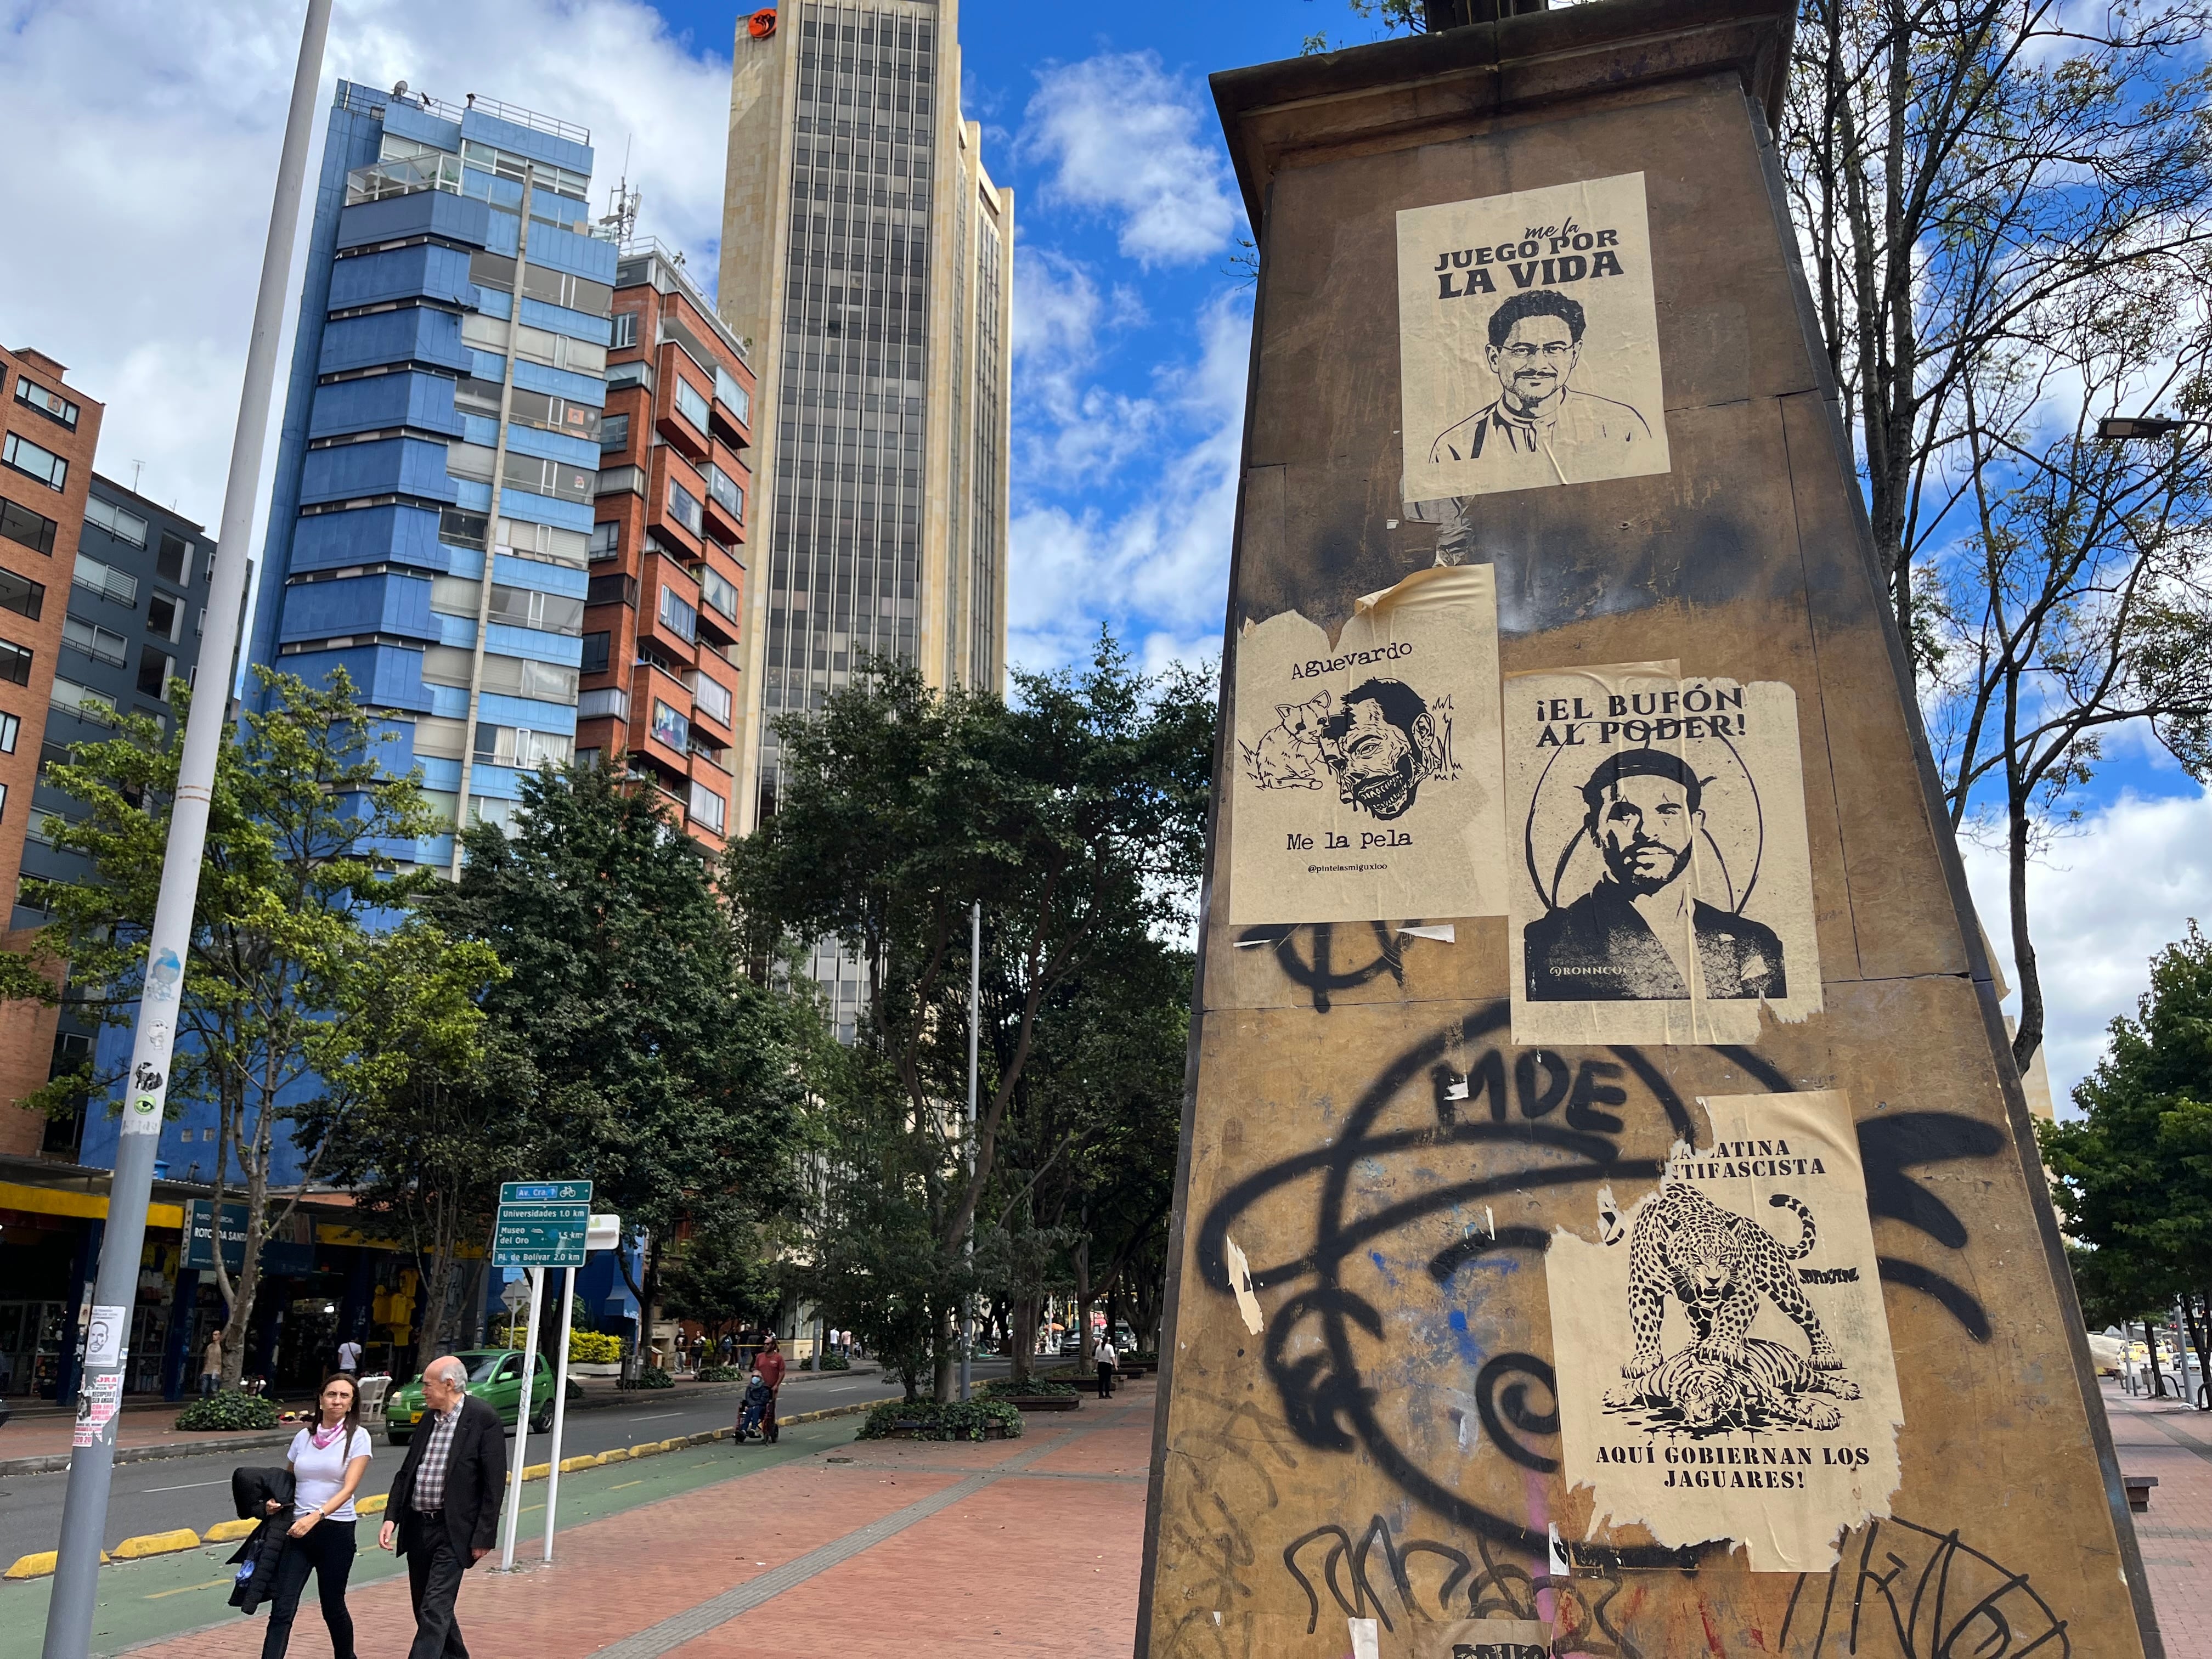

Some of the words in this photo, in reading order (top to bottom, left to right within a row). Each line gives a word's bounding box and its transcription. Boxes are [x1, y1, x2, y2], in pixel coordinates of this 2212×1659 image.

[1525, 226, 1559, 240] me
[1562, 216, 1580, 238] la
[1434, 242, 1539, 272] JUEGO
[1549, 229, 1620, 255] POR
[1438, 268, 1497, 300] LA
[1507, 250, 1624, 289] VIDA
[1291, 642, 1413, 680] Aguevardo
[1537, 698, 1593, 721] ¡EL
[1607, 684, 1743, 716] BUFÓN
[1536, 723, 1584, 748] AL
[1600, 714, 1746, 744] PODER!
[1286, 832, 1313, 850] Me
[1324, 832, 1350, 849] la
[1360, 829, 1413, 849] pela
[1710, 1139, 1791, 1159] ATINA
[1672, 1158, 1826, 1180] NTIFASCISTA
[1596, 1441, 1655, 1464] AQUÍ
[1664, 1446, 1813, 1465] GOBIERNAN
[1822, 1446, 1870, 1465] LOS
[1664, 1470, 1805, 1489] JAGUARES!
